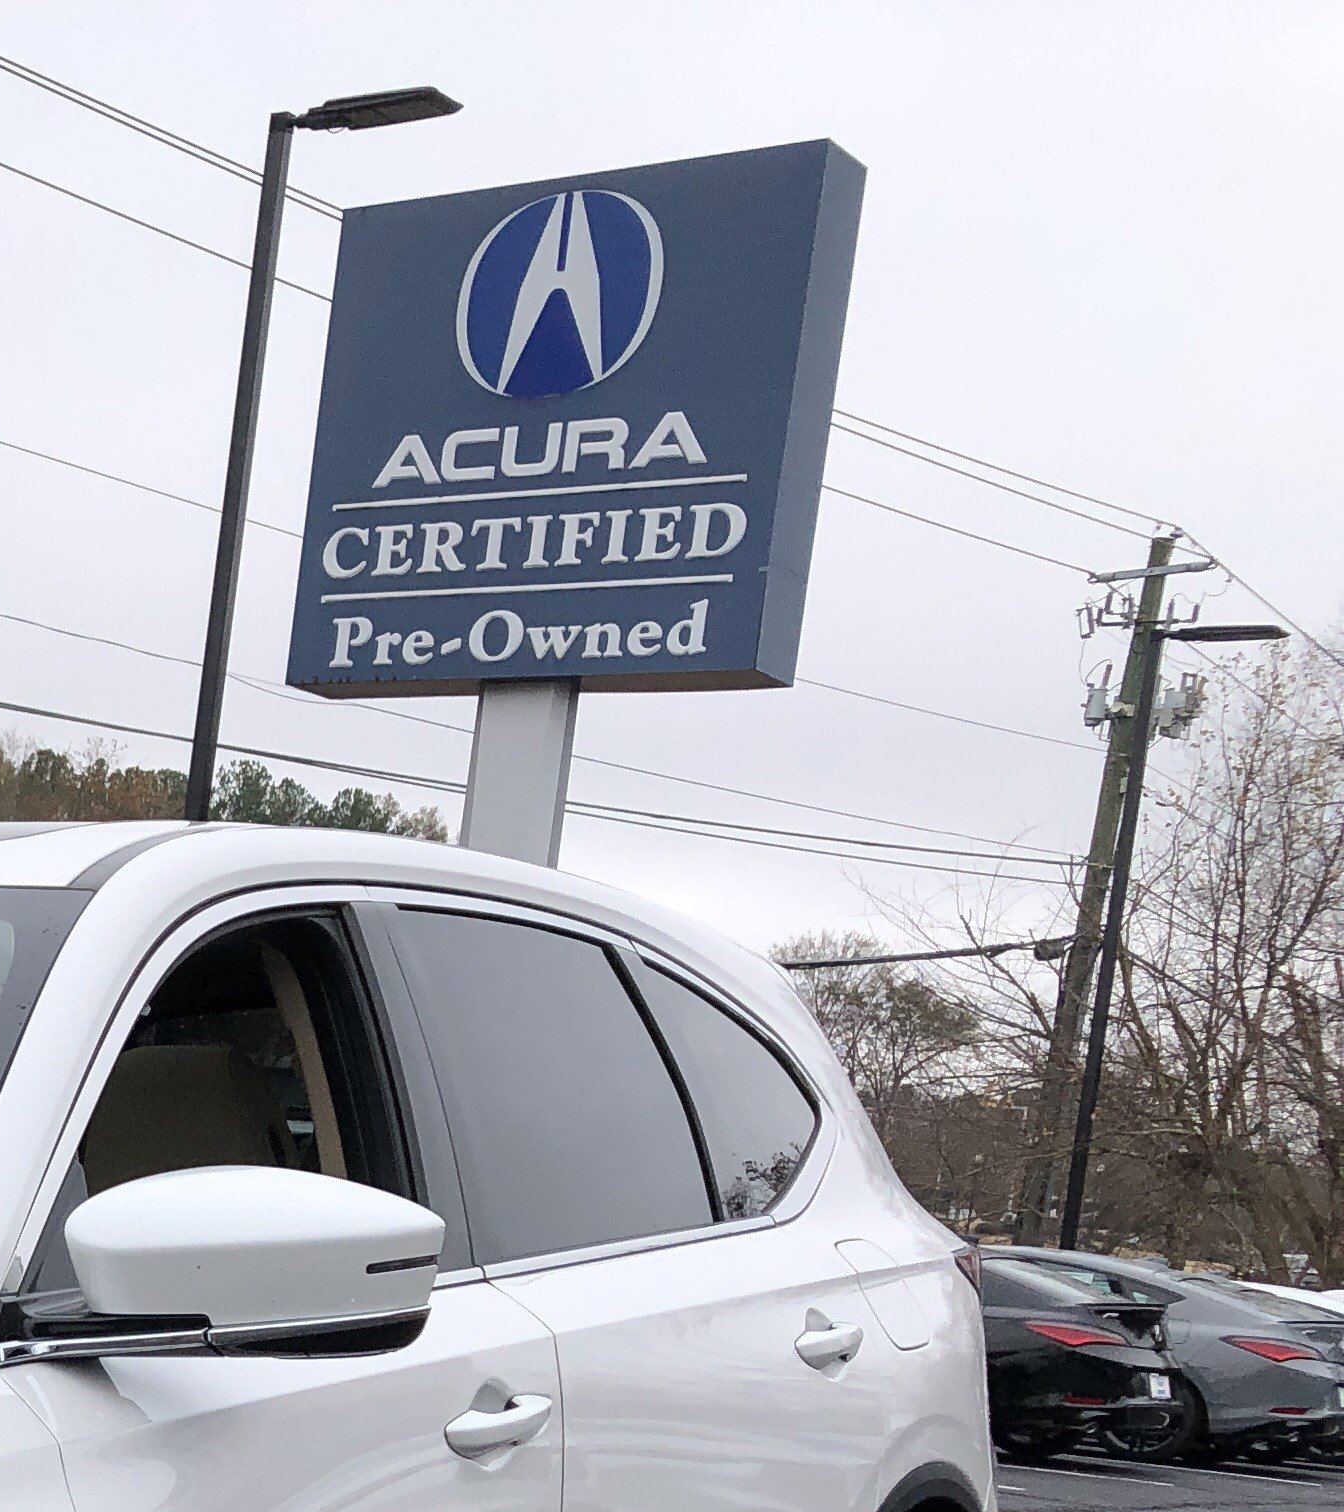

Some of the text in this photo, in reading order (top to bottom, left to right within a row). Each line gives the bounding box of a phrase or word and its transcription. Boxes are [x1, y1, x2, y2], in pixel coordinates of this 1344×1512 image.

[371, 410, 709, 490] ACURA
[320, 501, 748, 579] CERTIFIED
[327, 597, 710, 670] Pre-Owned
